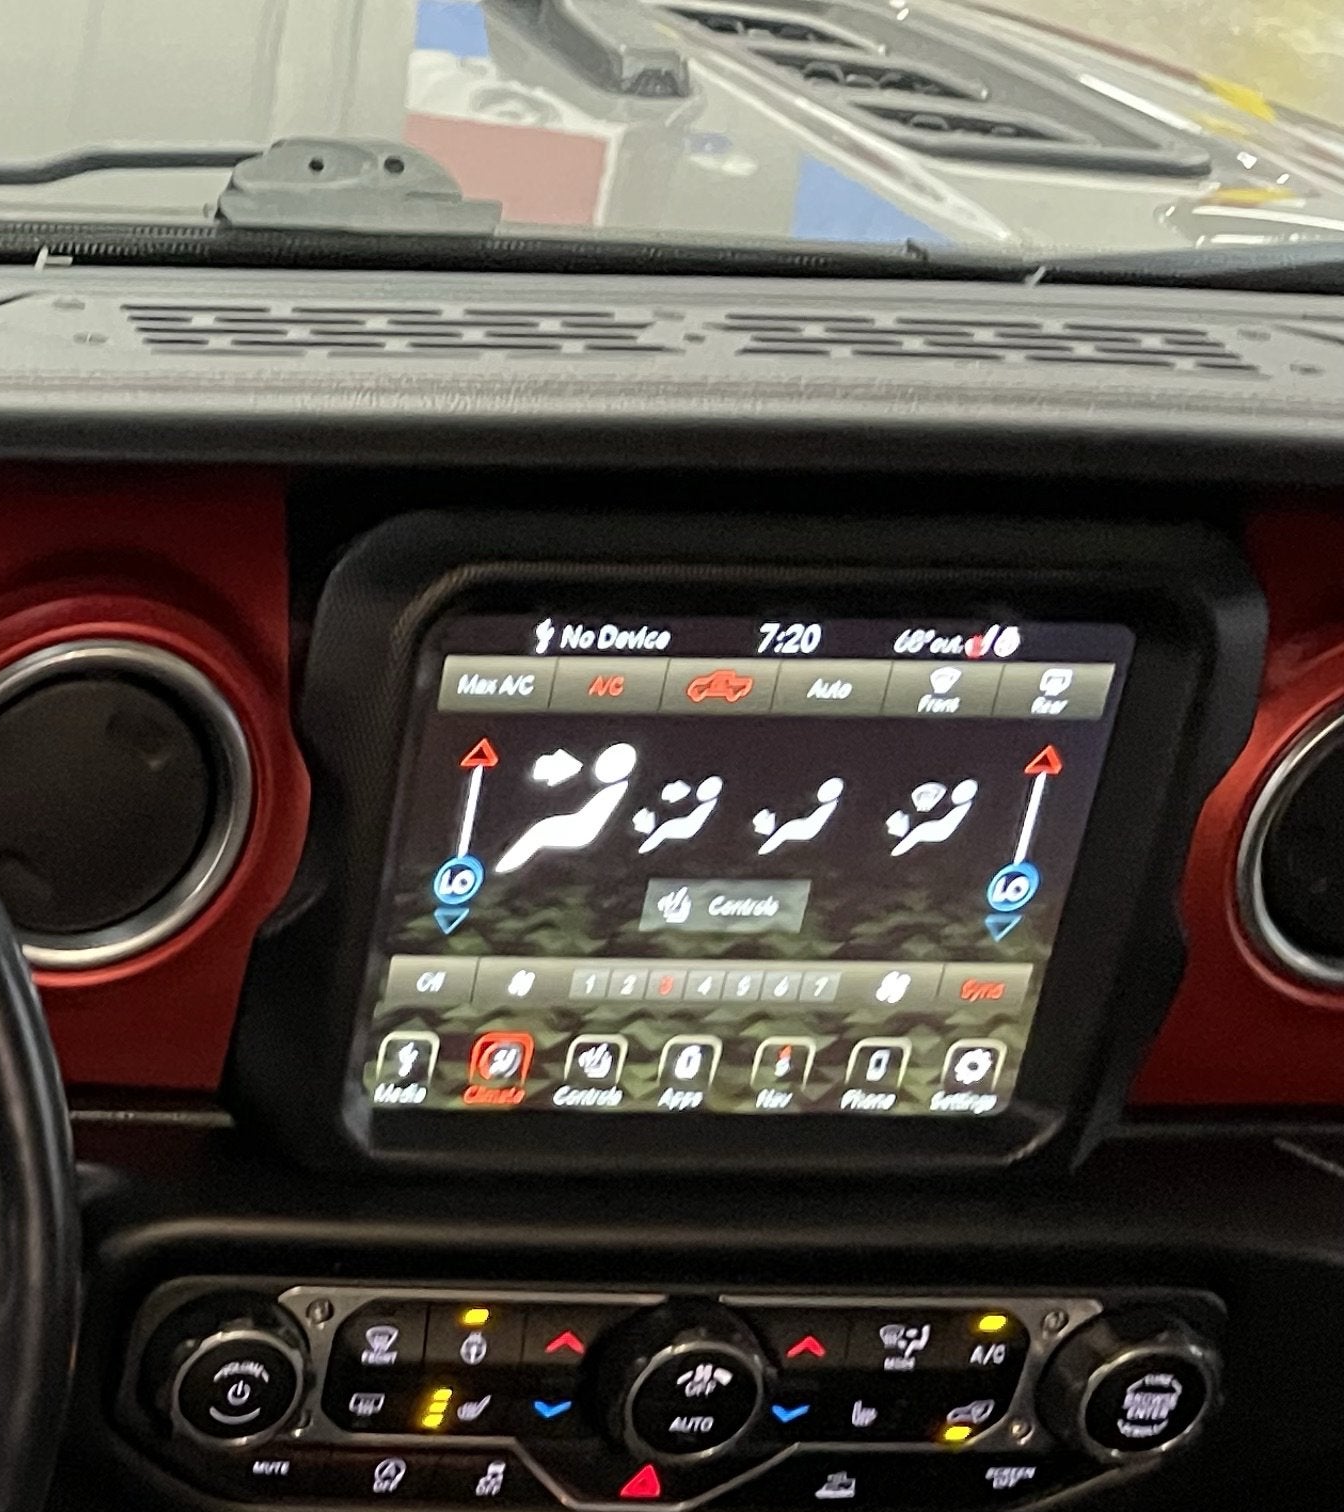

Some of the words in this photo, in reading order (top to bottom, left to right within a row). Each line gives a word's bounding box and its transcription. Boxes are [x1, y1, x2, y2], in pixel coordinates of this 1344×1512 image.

[561, 625, 596, 650] No
[597, 624, 672, 650] Device
[758, 623, 823, 653] 7:20
[456, 674, 497, 696] Max
[806, 678, 853, 700] Auto
[917, 695, 962, 714] Front
[438, 868, 476, 896] LO
[991, 875, 1030, 903] LO
[708, 895, 780, 917] Controls
[585, 974, 597, 994] 1
[620, 974, 637, 996] 2
[697, 975, 713, 996] 4
[374, 1082, 428, 1105] Media
[553, 1085, 624, 1107] Controls
[657, 1087, 704, 1111] Apps
[839, 1088, 898, 1111] Phone
[928, 1090, 998, 1115] Settings
[970, 1344, 1006, 1366] A/C
[669, 1415, 714, 1433] AUTO
[252, 1460, 290, 1476] MUTE
